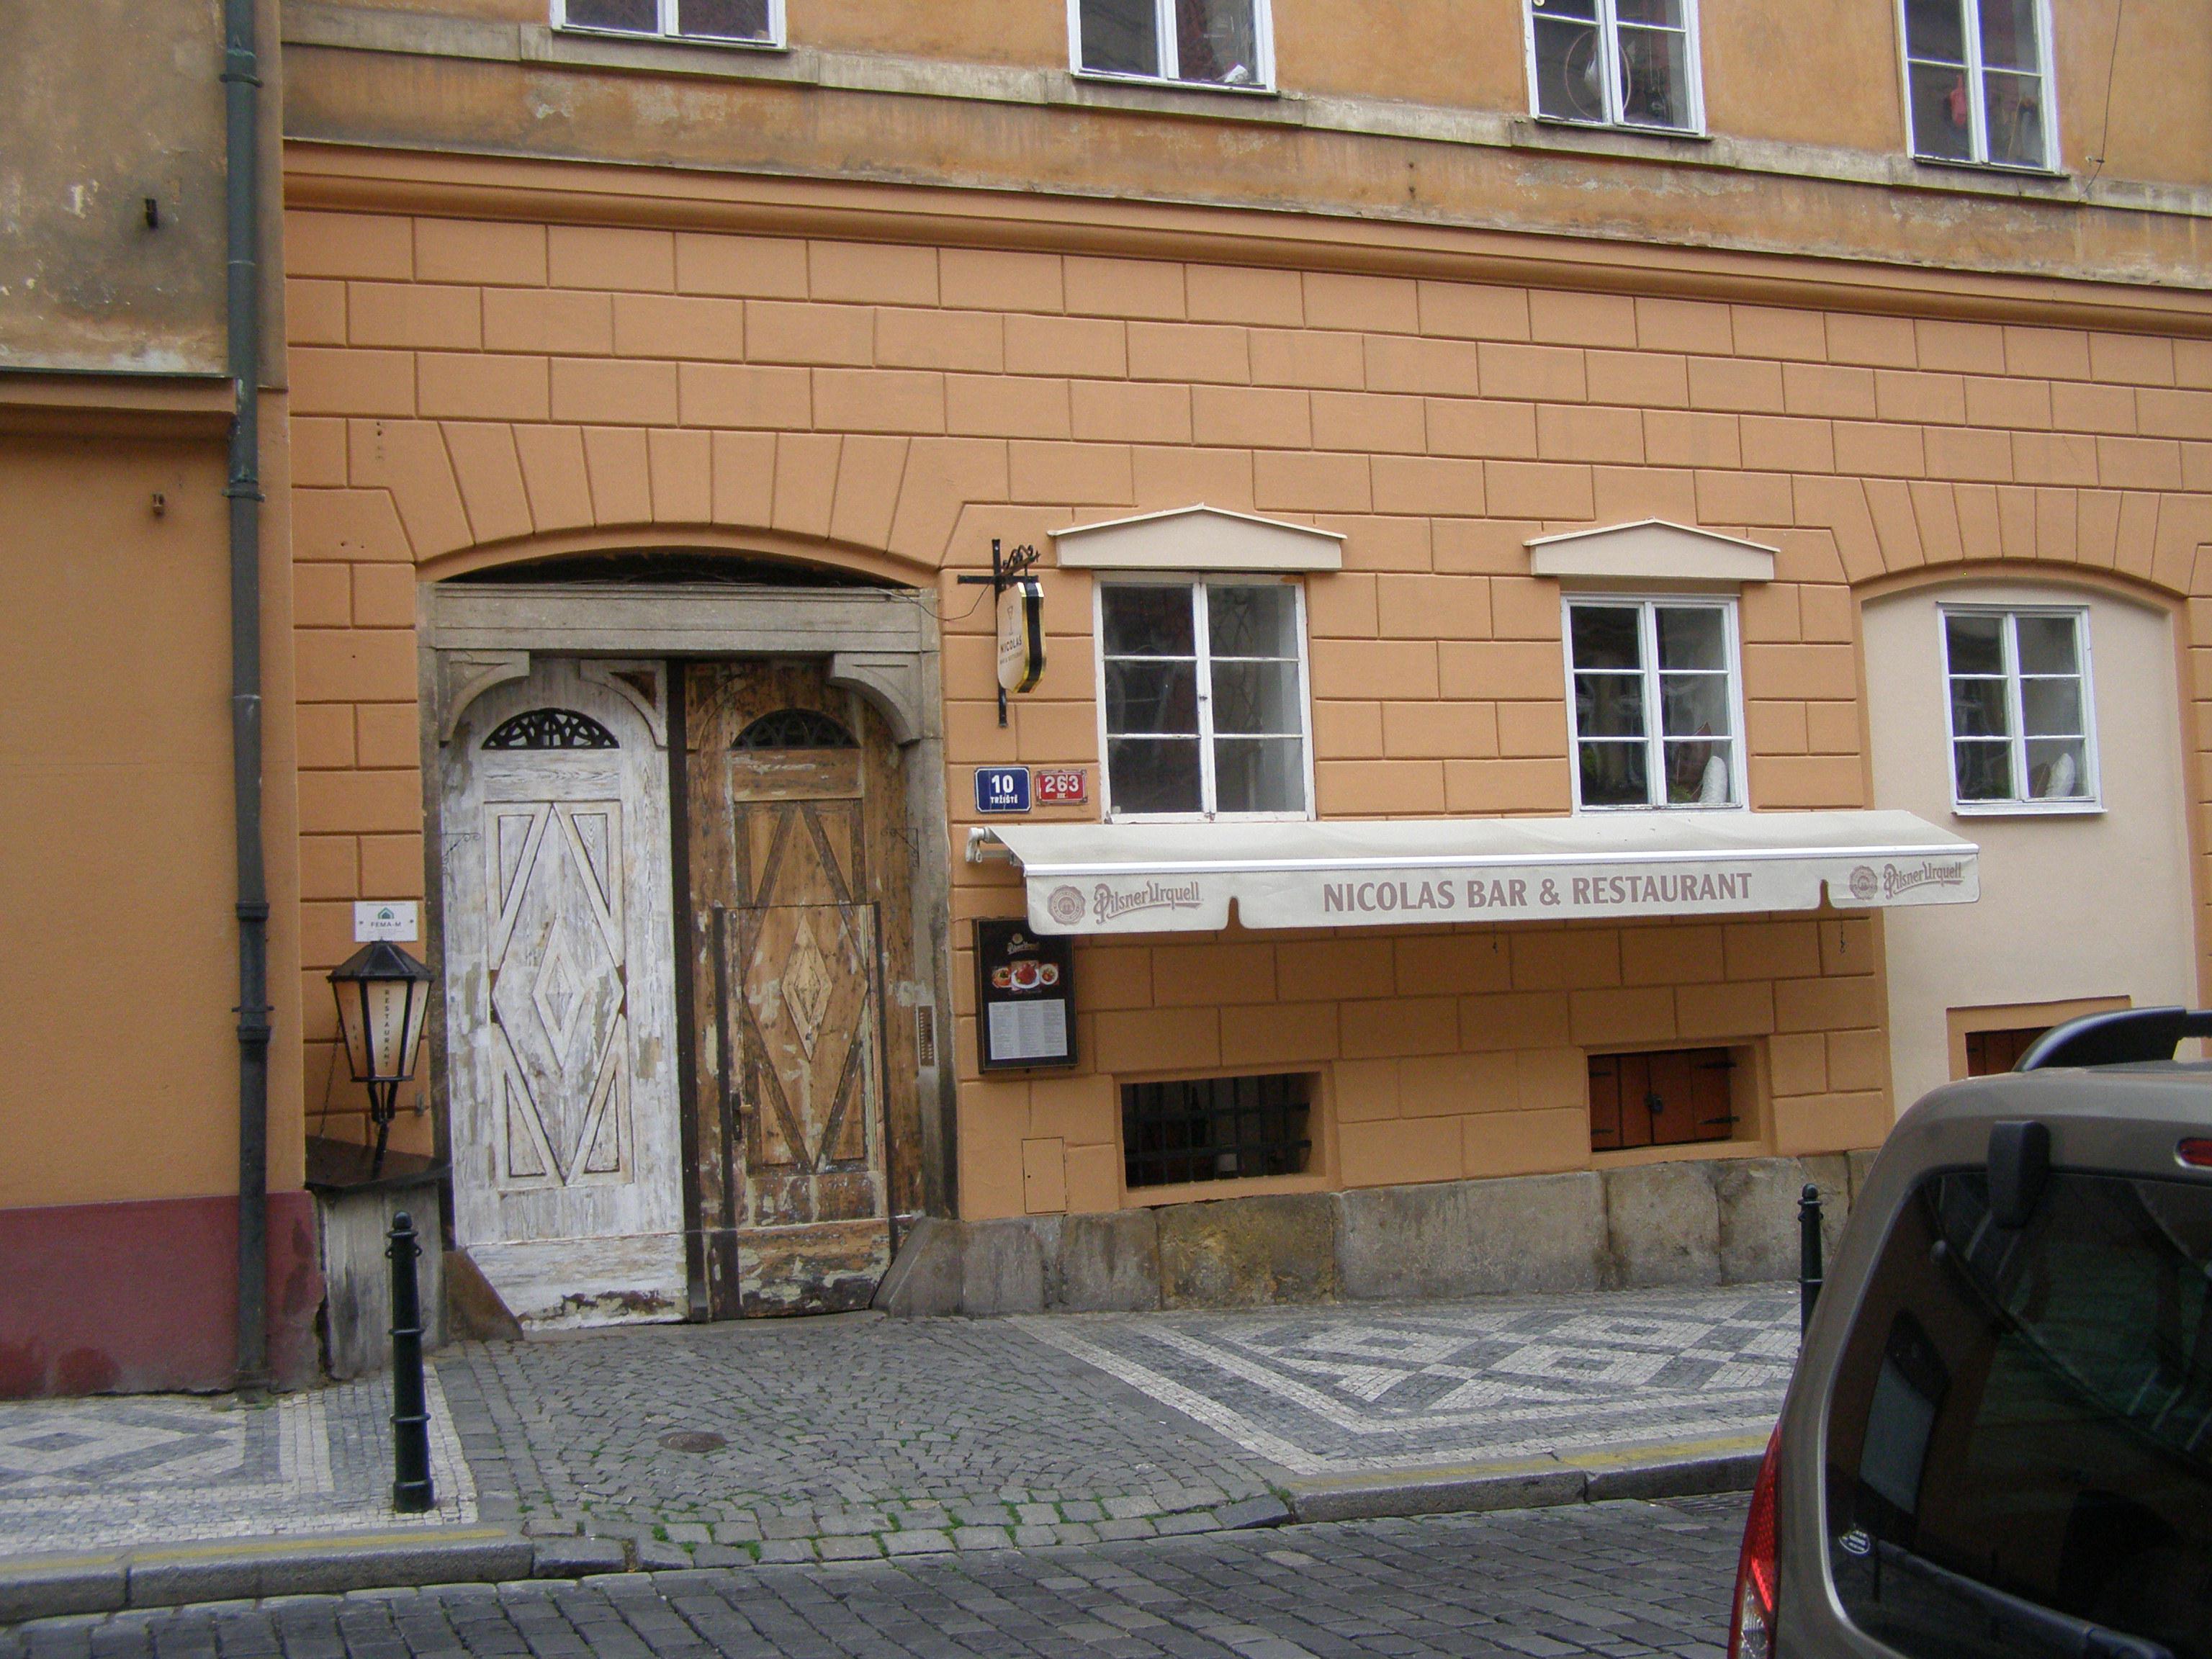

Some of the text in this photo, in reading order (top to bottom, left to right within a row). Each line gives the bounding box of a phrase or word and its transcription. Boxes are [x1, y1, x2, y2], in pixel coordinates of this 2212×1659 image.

[1001, 635, 1022, 652] NICOLAS
[992, 775, 1014, 793] 10
[1045, 775, 1079, 793] 263
[1323, 873, 1752, 912] NICOLAS BAR & RESTAURANT
[1883, 861, 1962, 899] Pilsner Urquell
[1093, 880, 1200, 925] Pilsner Urquell
